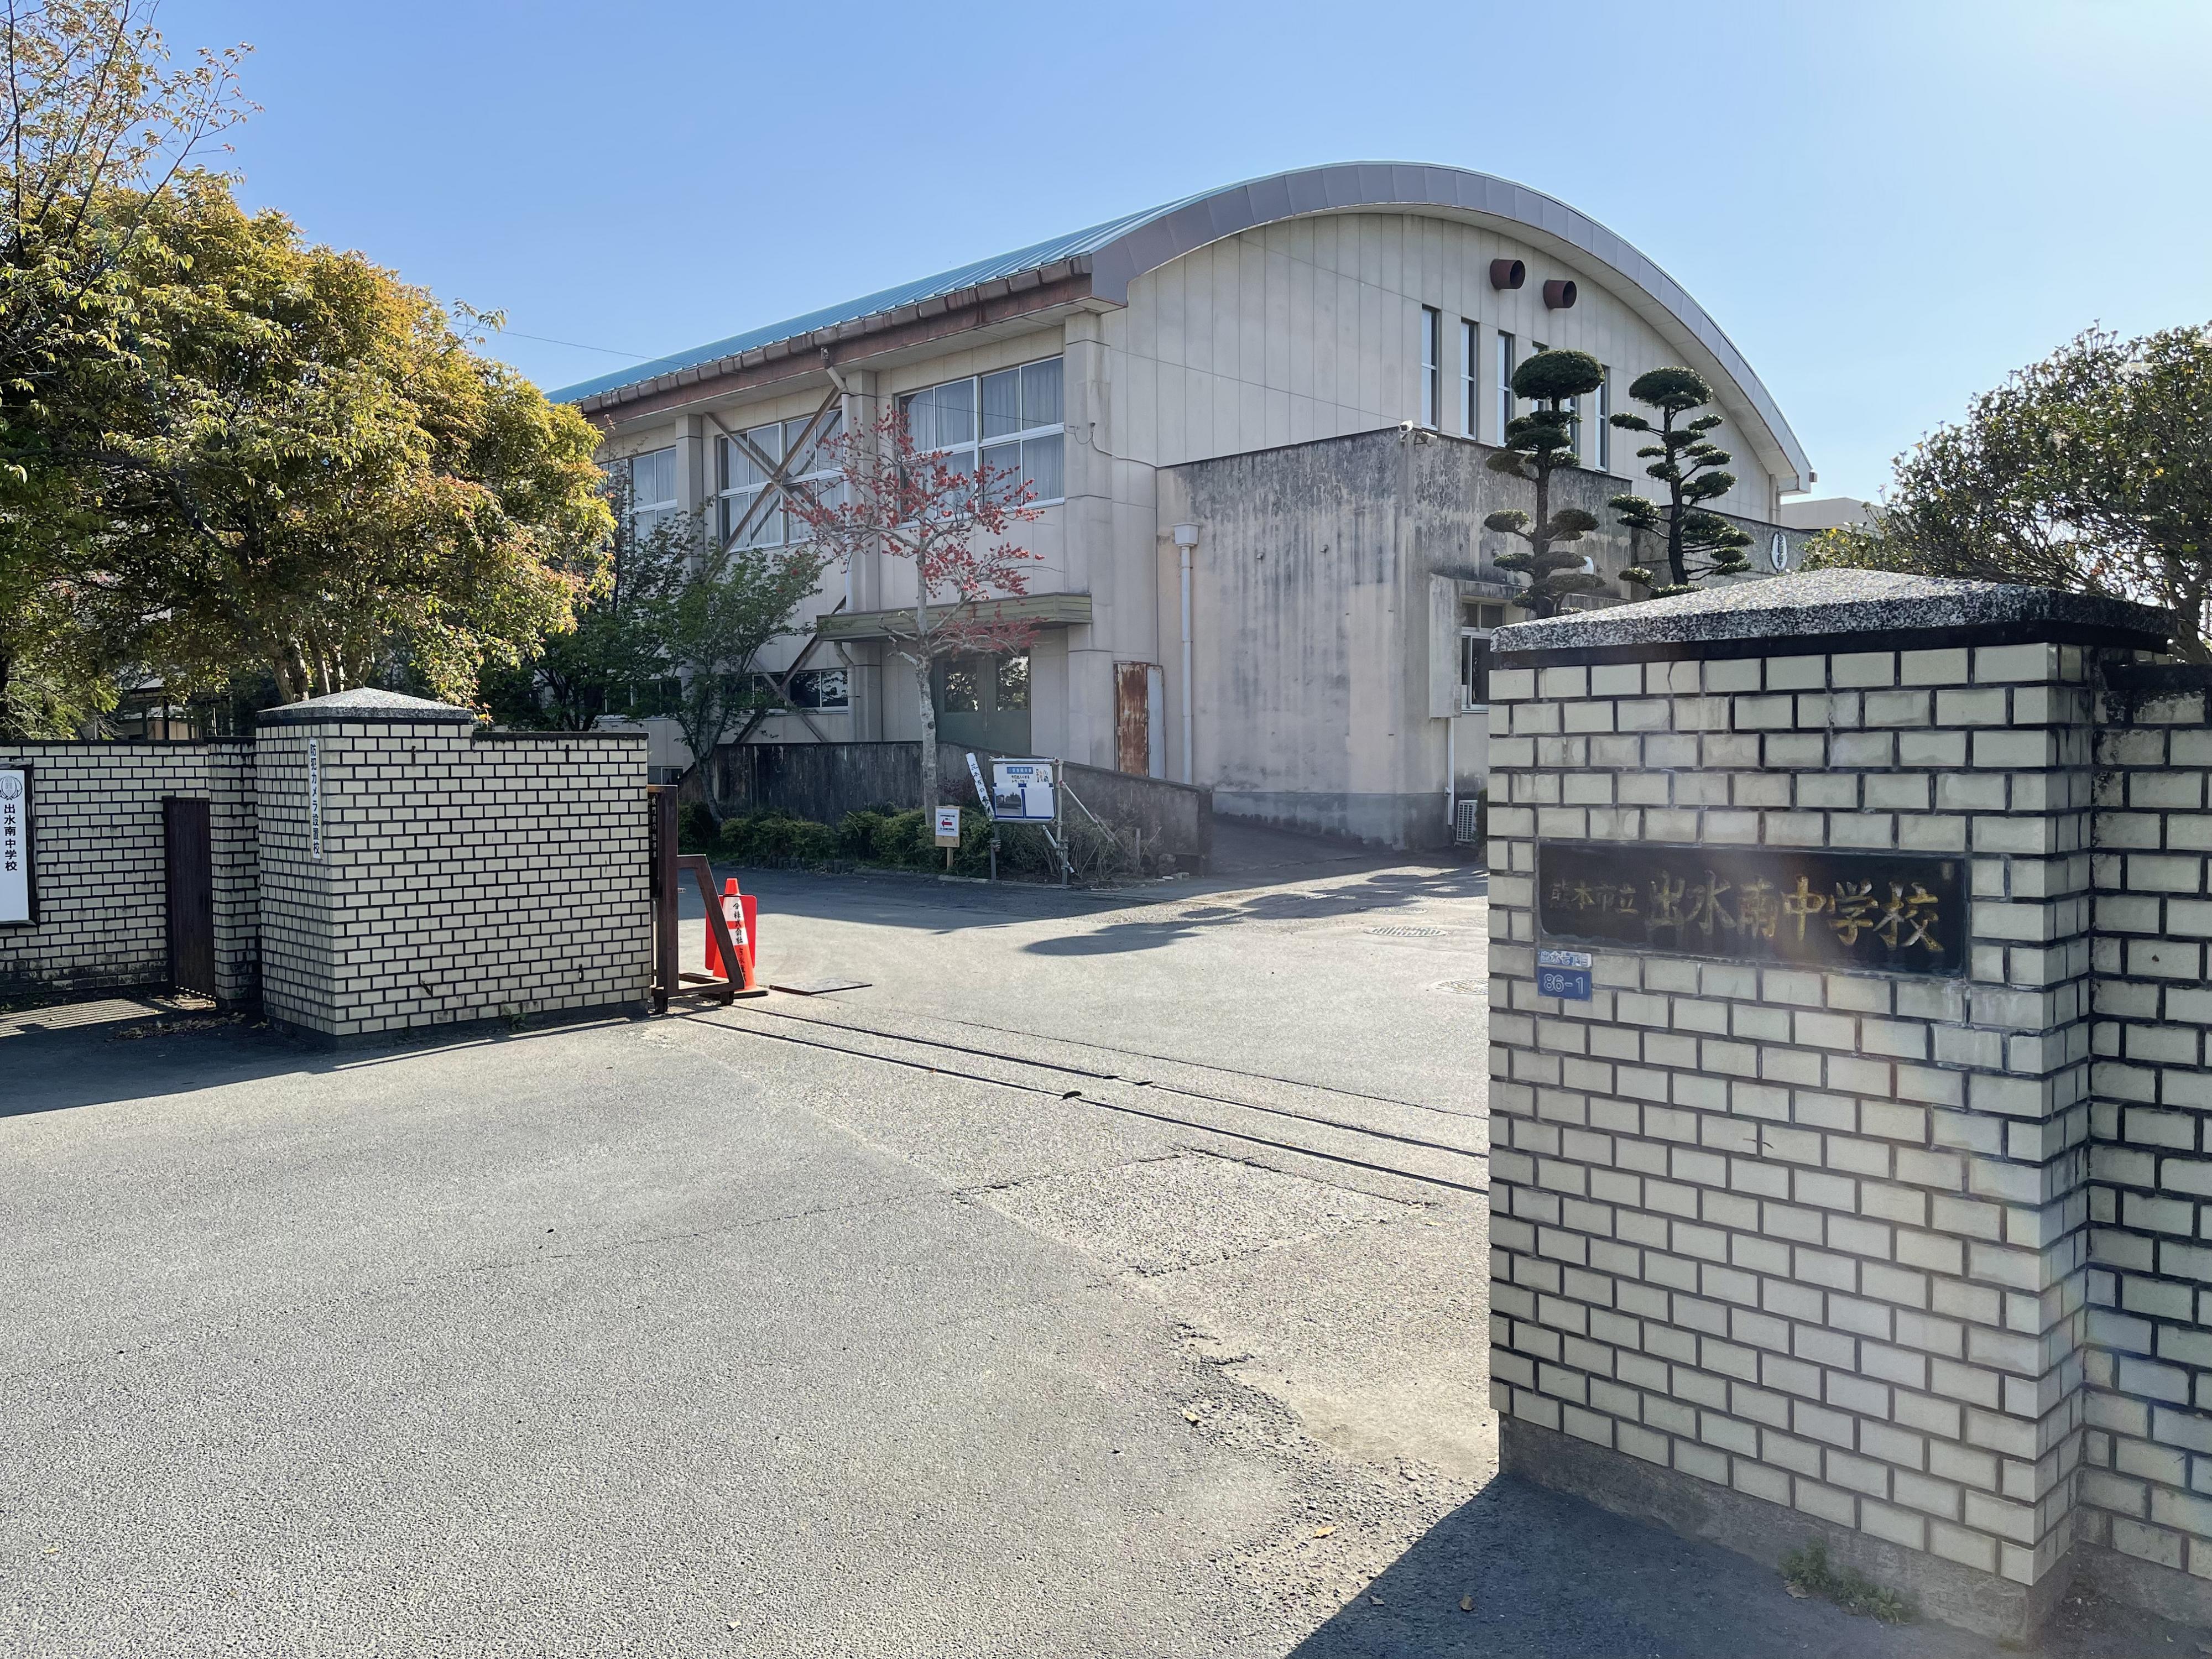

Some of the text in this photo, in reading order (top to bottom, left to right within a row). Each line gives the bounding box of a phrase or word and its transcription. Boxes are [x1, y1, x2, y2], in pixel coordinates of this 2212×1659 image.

[310, 743, 320, 854] 防犯カメラ設置校
[4, 804, 18, 871] 出水南中学校
[1541, 951, 1588, 967] 出水七丁目
[1543, 973, 1584, 994] 86-1
